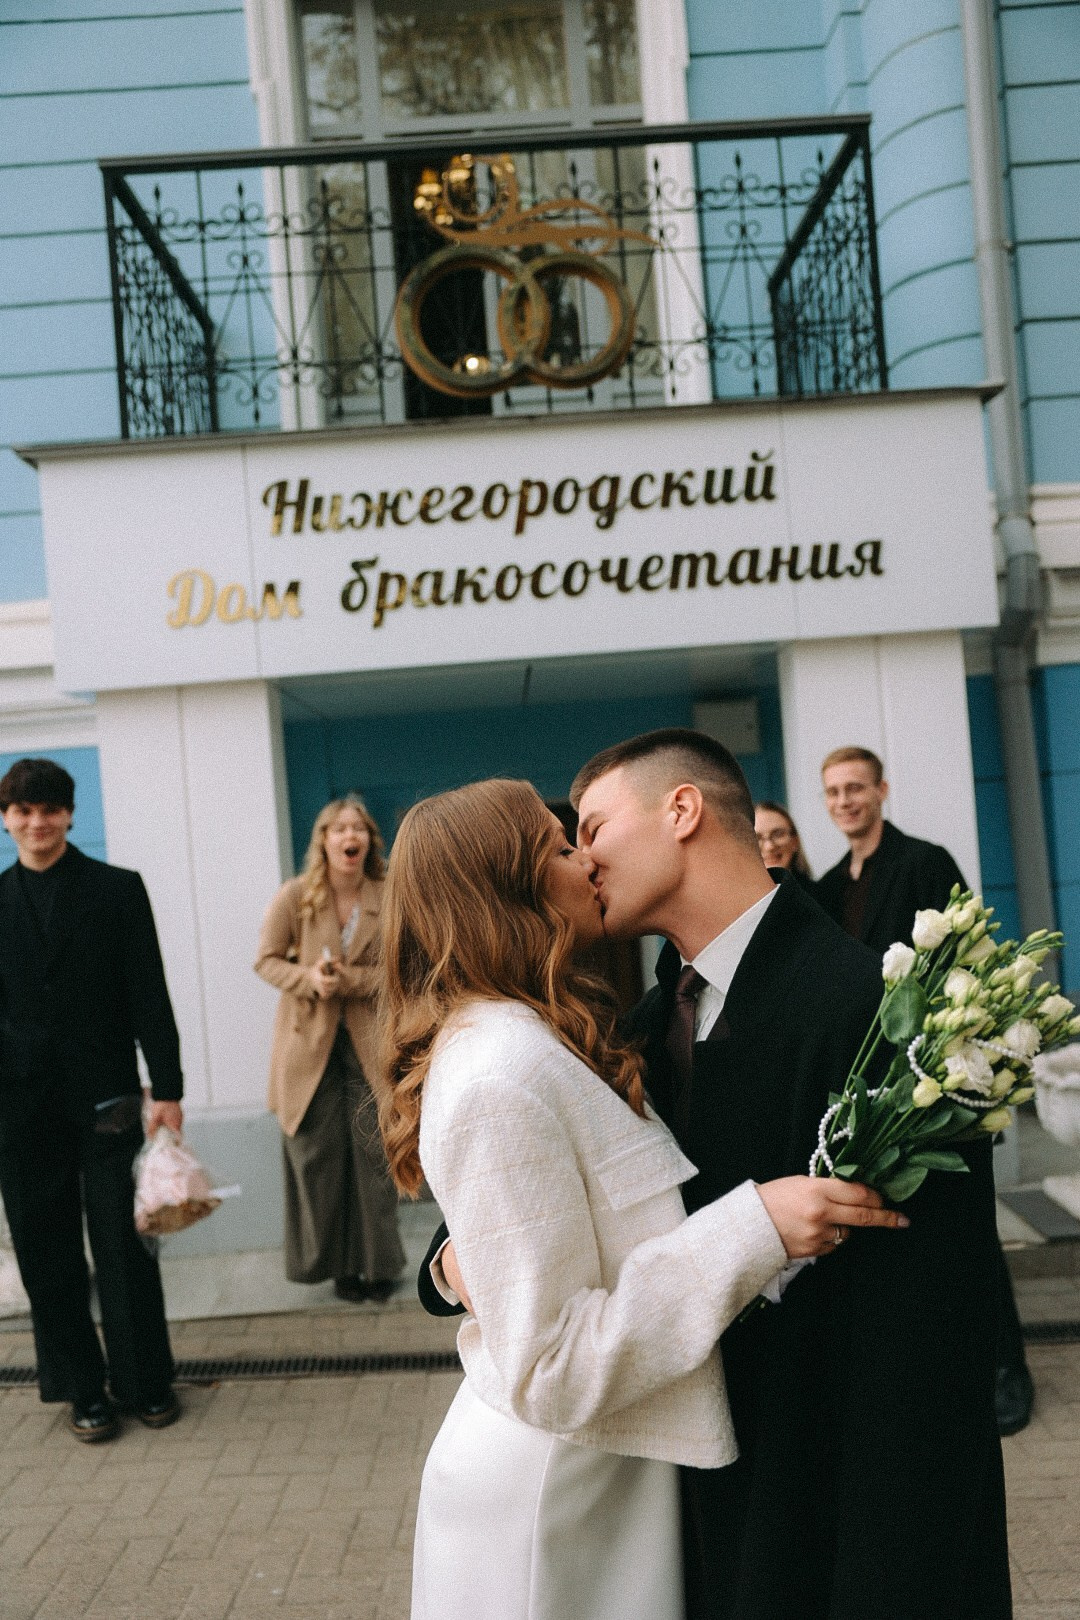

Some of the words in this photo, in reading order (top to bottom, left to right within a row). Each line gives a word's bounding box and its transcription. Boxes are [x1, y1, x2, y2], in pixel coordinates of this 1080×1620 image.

[262, 450, 777, 535] Нижегородский
[168, 567, 304, 629] Дом
[341, 538, 885, 628] бракосочетания
